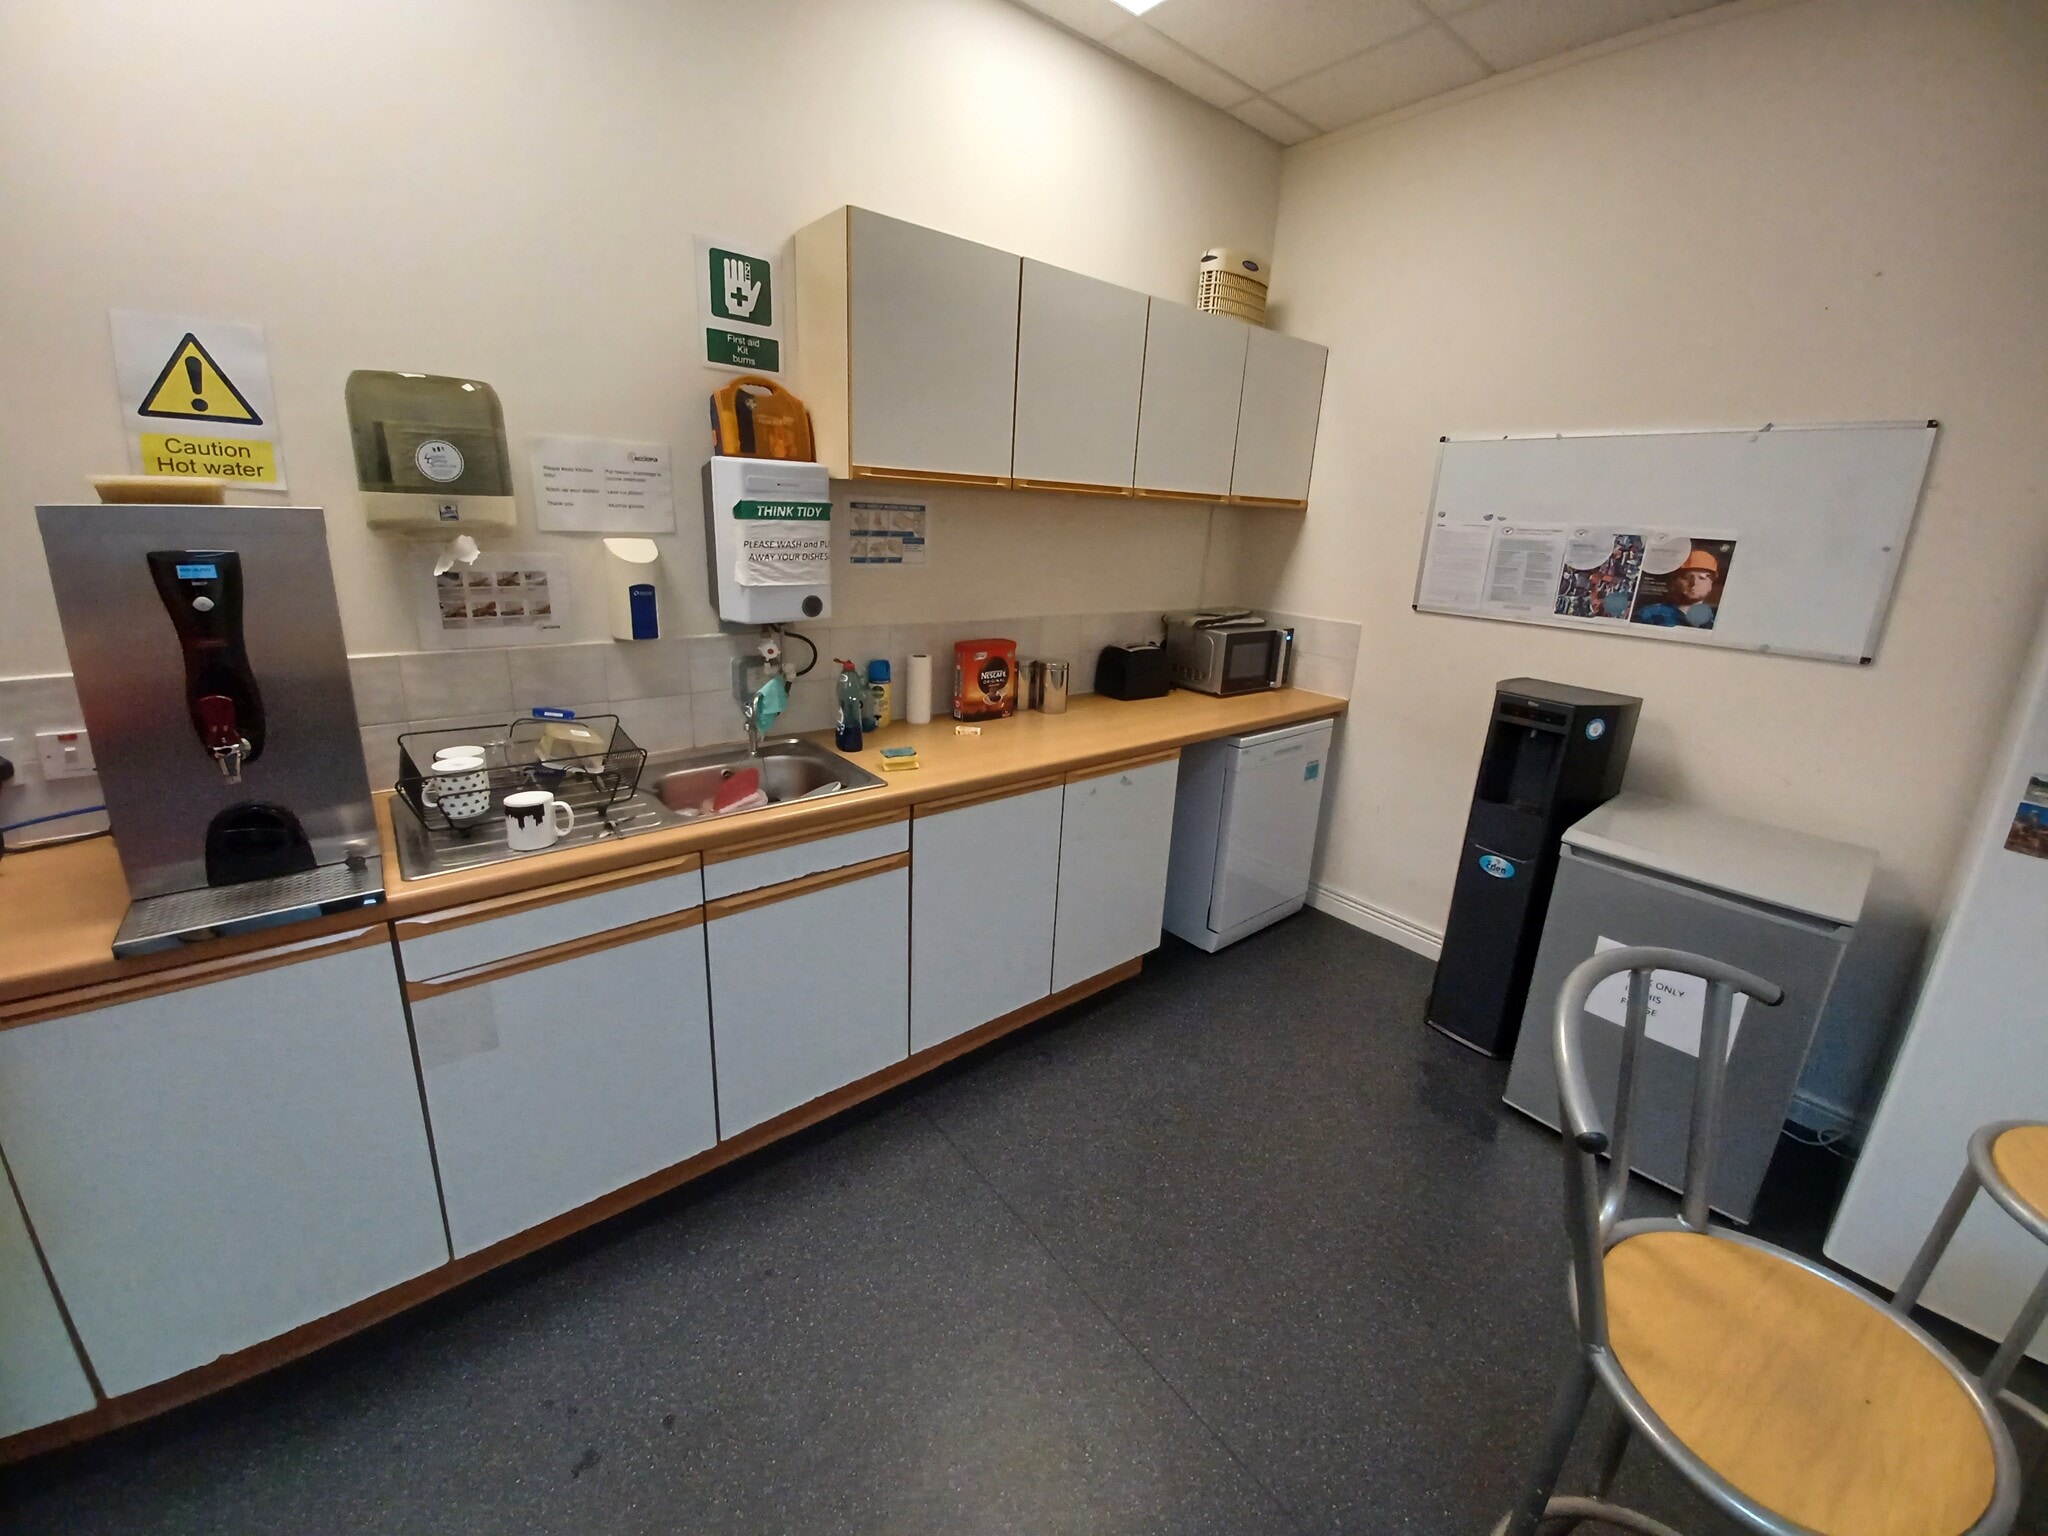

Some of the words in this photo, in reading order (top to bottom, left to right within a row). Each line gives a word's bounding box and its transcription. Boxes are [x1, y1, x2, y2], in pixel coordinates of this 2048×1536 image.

[727, 334, 746, 345] First
[748, 337, 760, 347] aid
[737, 346, 749, 355] Kit
[732, 354, 756, 366] burns
[165, 438, 251, 458] Caution
[157, 457, 198, 474] Hot
[203, 462, 264, 477] water
[757, 506, 794, 517] THINK
[797, 506, 822, 517] TIDY
[743, 540, 774, 549] PLEASE
[776, 540, 802, 549] WASH
[803, 541, 818, 549] and
[749, 553, 776, 562] AWAY
[777, 552, 800, 561] YOUR
[801, 552, 829, 561] DISHES
[1655, 982, 1685, 998] ONLY
